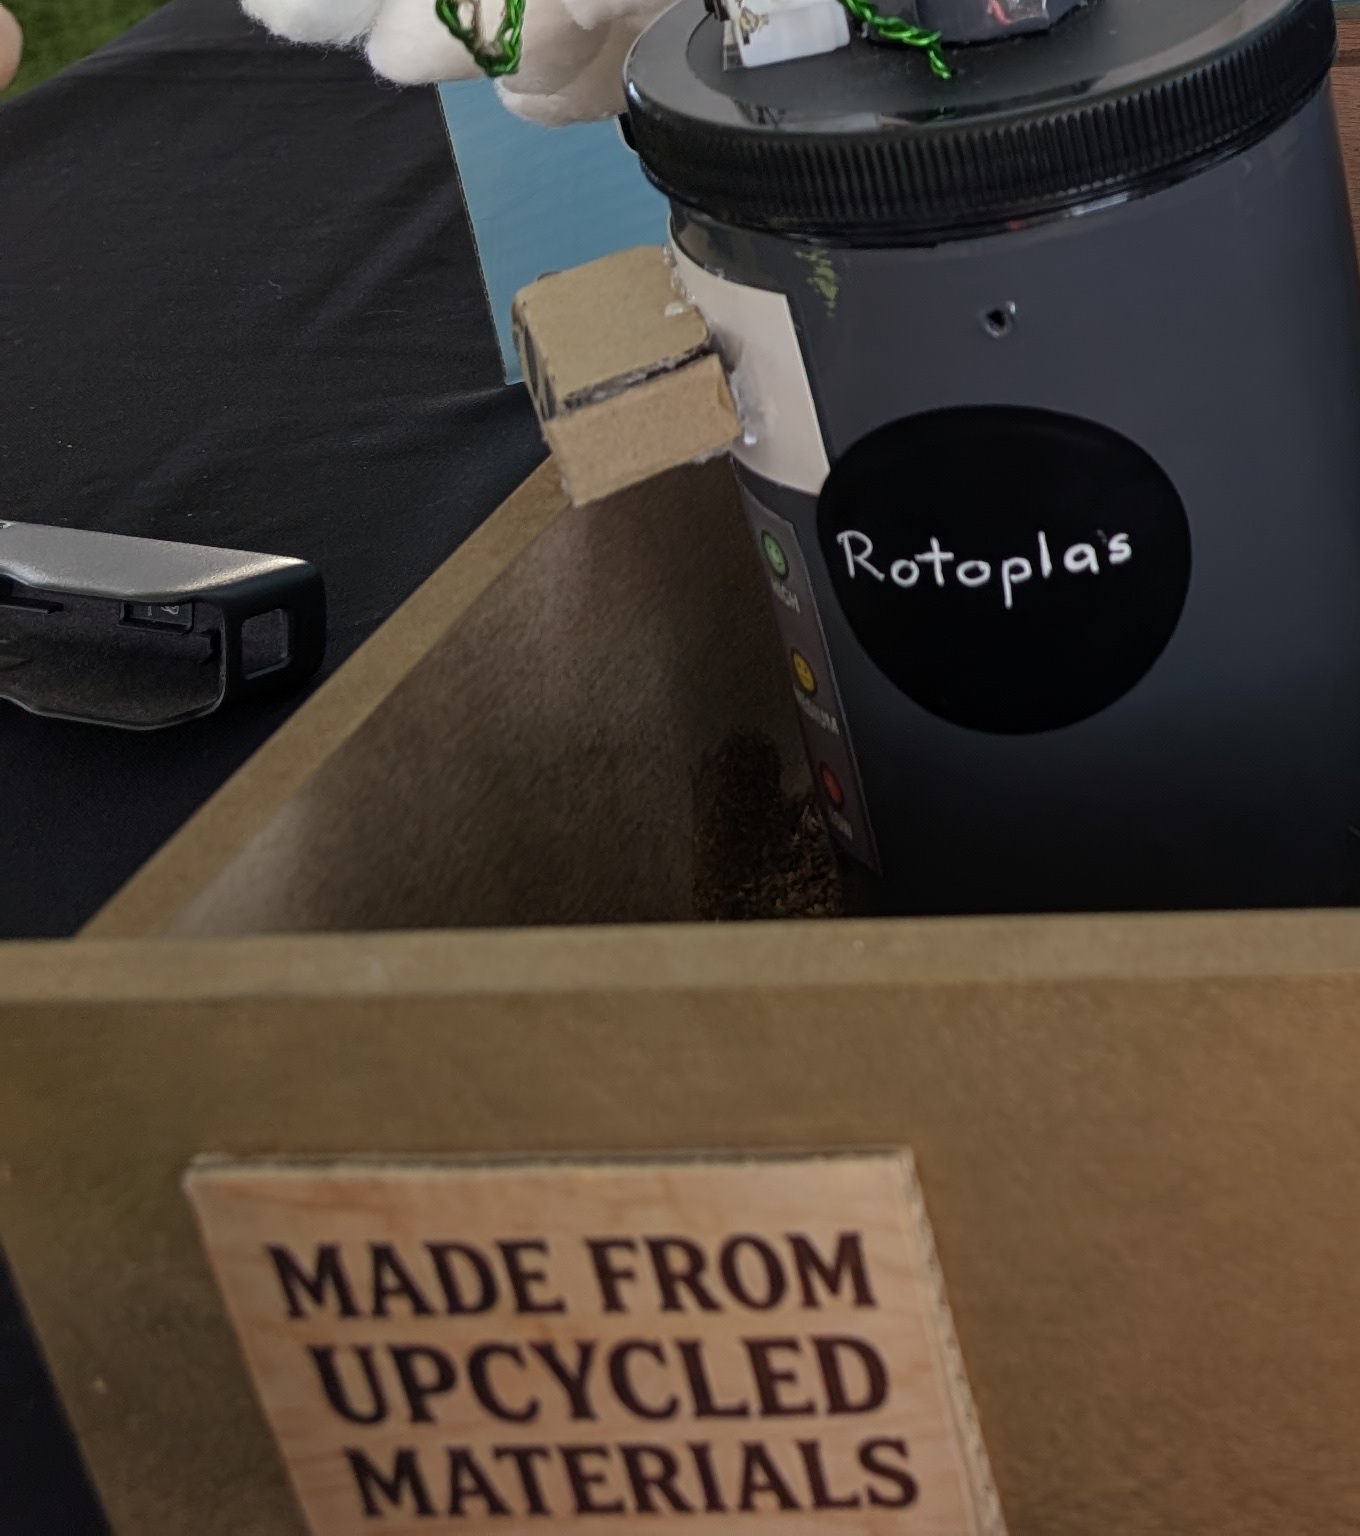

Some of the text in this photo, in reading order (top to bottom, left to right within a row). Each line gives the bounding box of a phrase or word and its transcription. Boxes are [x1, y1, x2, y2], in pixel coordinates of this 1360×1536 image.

[835, 529, 1132, 610] Rotoplas
[264, 1231, 877, 1321] MADE FROM
[308, 1334, 890, 1426] UPCYCLED
[342, 1437, 921, 1519] MATERIALS
